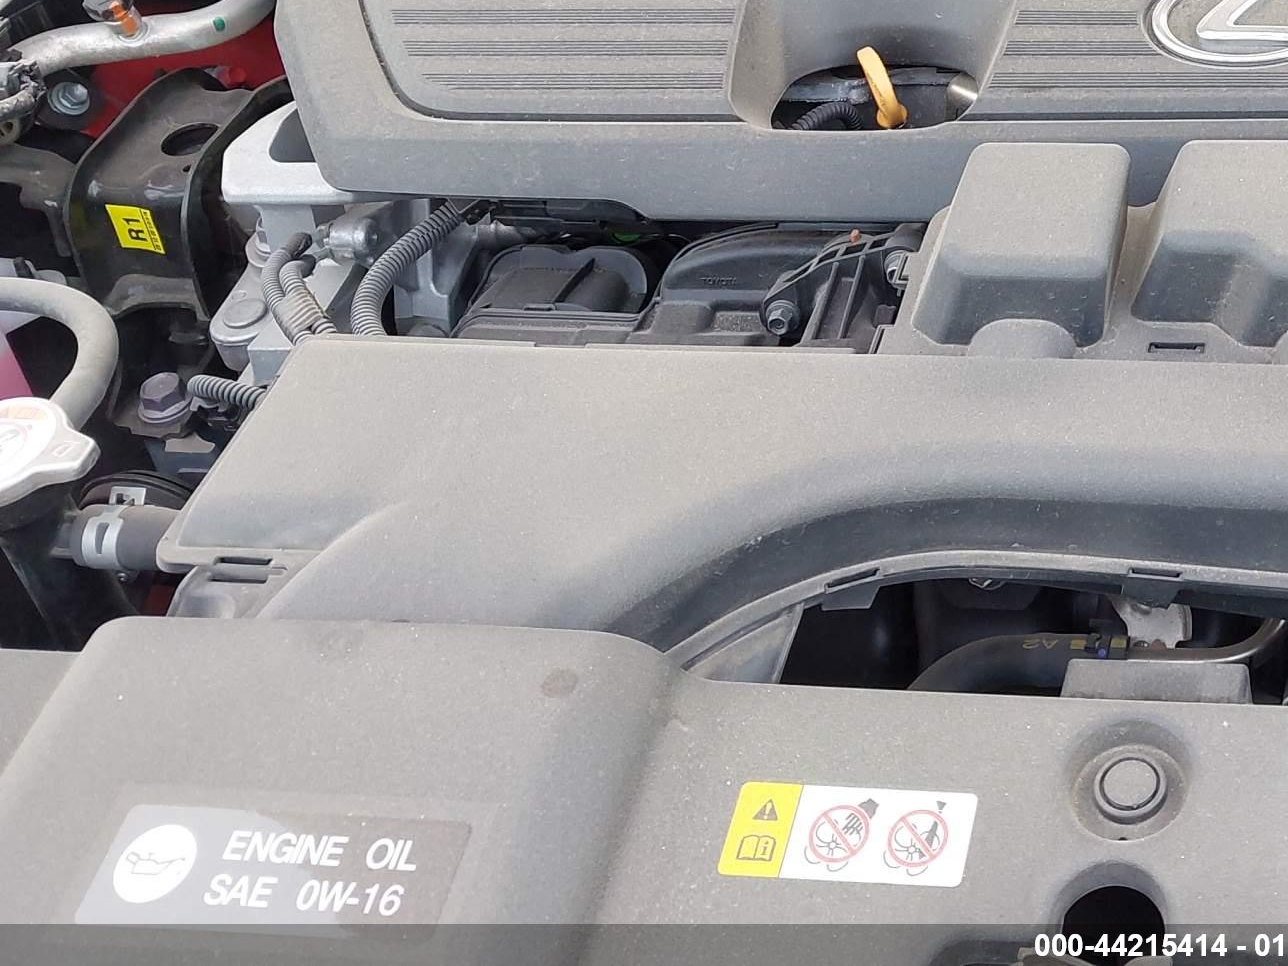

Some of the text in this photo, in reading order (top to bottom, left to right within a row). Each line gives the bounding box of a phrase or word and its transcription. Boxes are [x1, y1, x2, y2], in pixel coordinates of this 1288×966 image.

[122, 217, 148, 242] R1
[1022, 638, 1059, 650] A2
[222, 831, 417, 872] ENGINE OIL
[203, 873, 405, 916] SAE 0W-16
